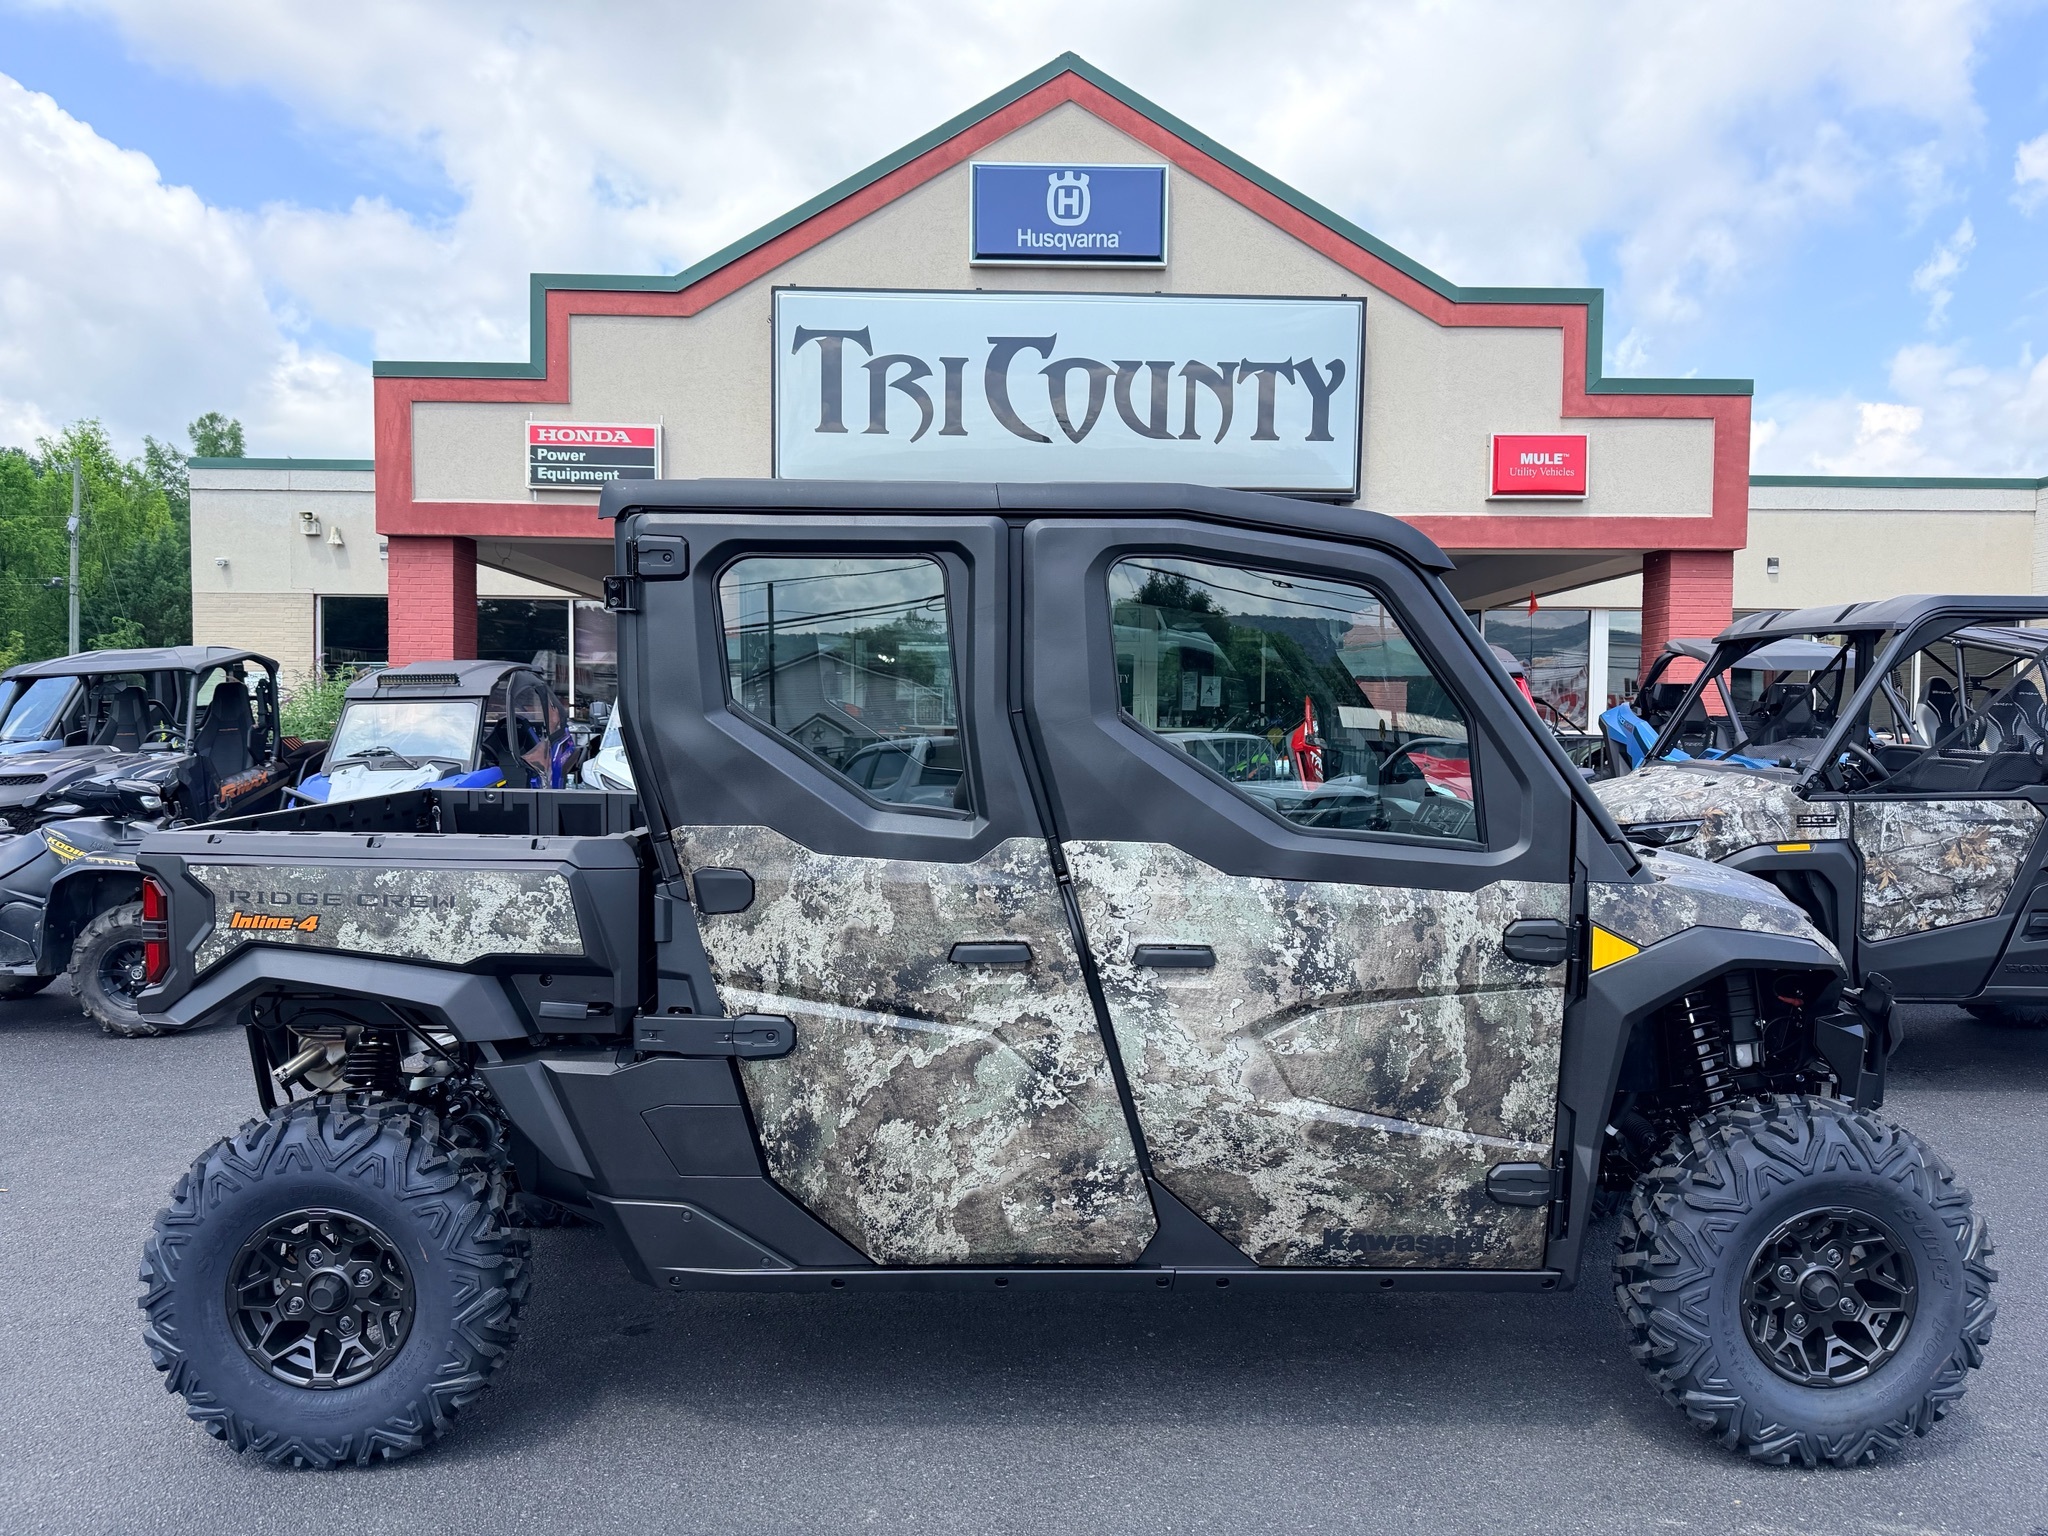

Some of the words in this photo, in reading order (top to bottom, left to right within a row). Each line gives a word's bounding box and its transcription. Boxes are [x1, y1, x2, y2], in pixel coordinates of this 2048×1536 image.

[1017, 228, 1119, 251] Husqvarna
[537, 428, 632, 443] HONDA
[537, 448, 586, 462] Power
[537, 466, 620, 482] Equipment
[1509, 467, 1538, 478] Utility
[1540, 467, 1575, 477] Vehicles
[229, 890, 343, 906] RIDGE
[356, 893, 456, 909] CREW
[229, 911, 321, 933] Inline-4
[1323, 1227, 1488, 1252] Kawasaki
